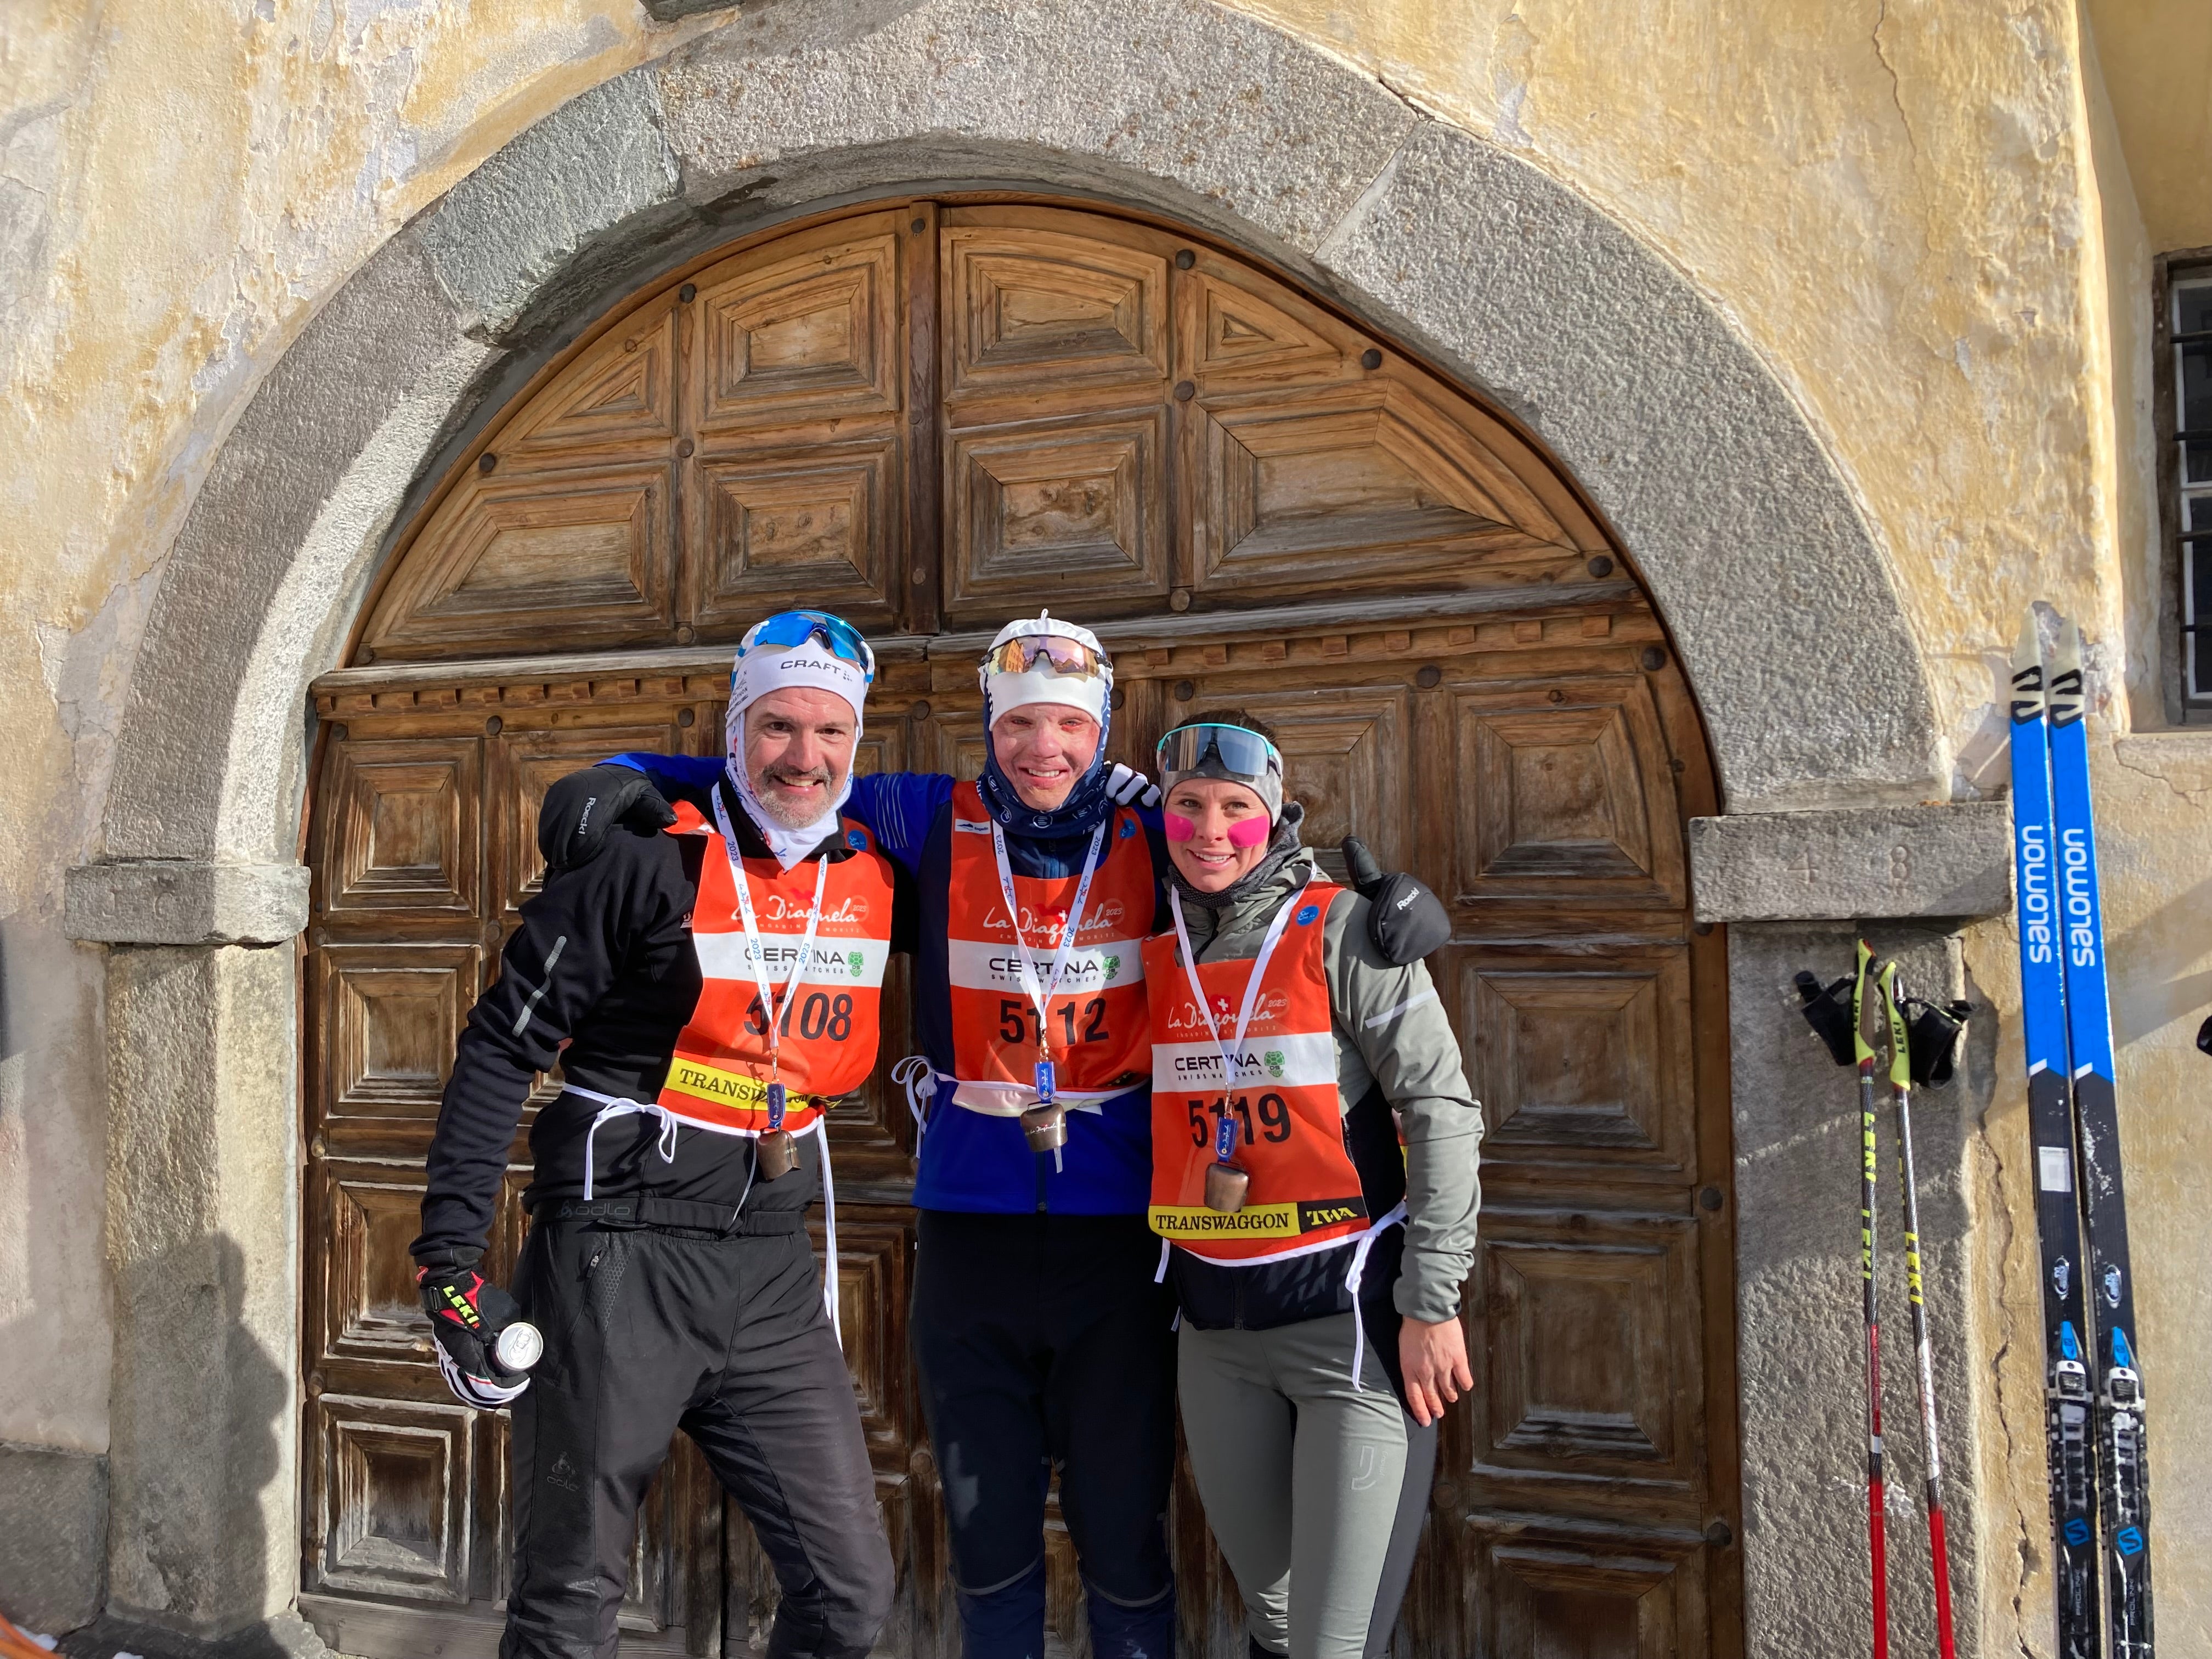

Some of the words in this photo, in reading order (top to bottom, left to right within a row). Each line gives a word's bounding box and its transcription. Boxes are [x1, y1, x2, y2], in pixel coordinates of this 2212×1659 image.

[781, 659, 840, 674] CRAFT
[578, 797, 597, 834] Roeckl
[727, 841, 739, 861] 2023
[996, 834, 1004, 855] 2023
[1091, 836, 1101, 855] 2023
[2021, 825, 2052, 963] salomon
[2063, 828, 2095, 967] salomon
[983, 906, 1011, 929] La
[1105, 907, 1122, 916] 2023
[1063, 926, 1075, 947] 2023
[744, 947, 845, 965] CERINA
[750, 938, 761, 960] 2023
[798, 943, 810, 964] 2023
[1268, 998, 1287, 1008] 2023
[744, 991, 853, 1041] 5108
[1000, 997, 1109, 1047] 5112
[1168, 1006, 1182, 1029] La
[1893, 1022, 1906, 1053] LEKI
[1212, 1070, 1262, 1079] WACHES
[576, 1203, 630, 1216] odlo
[1155, 1212, 1289, 1231] TRANSWAGGON
[1905, 1231, 1923, 1305] LEKI
[443, 1285, 479, 1324] LEKI
